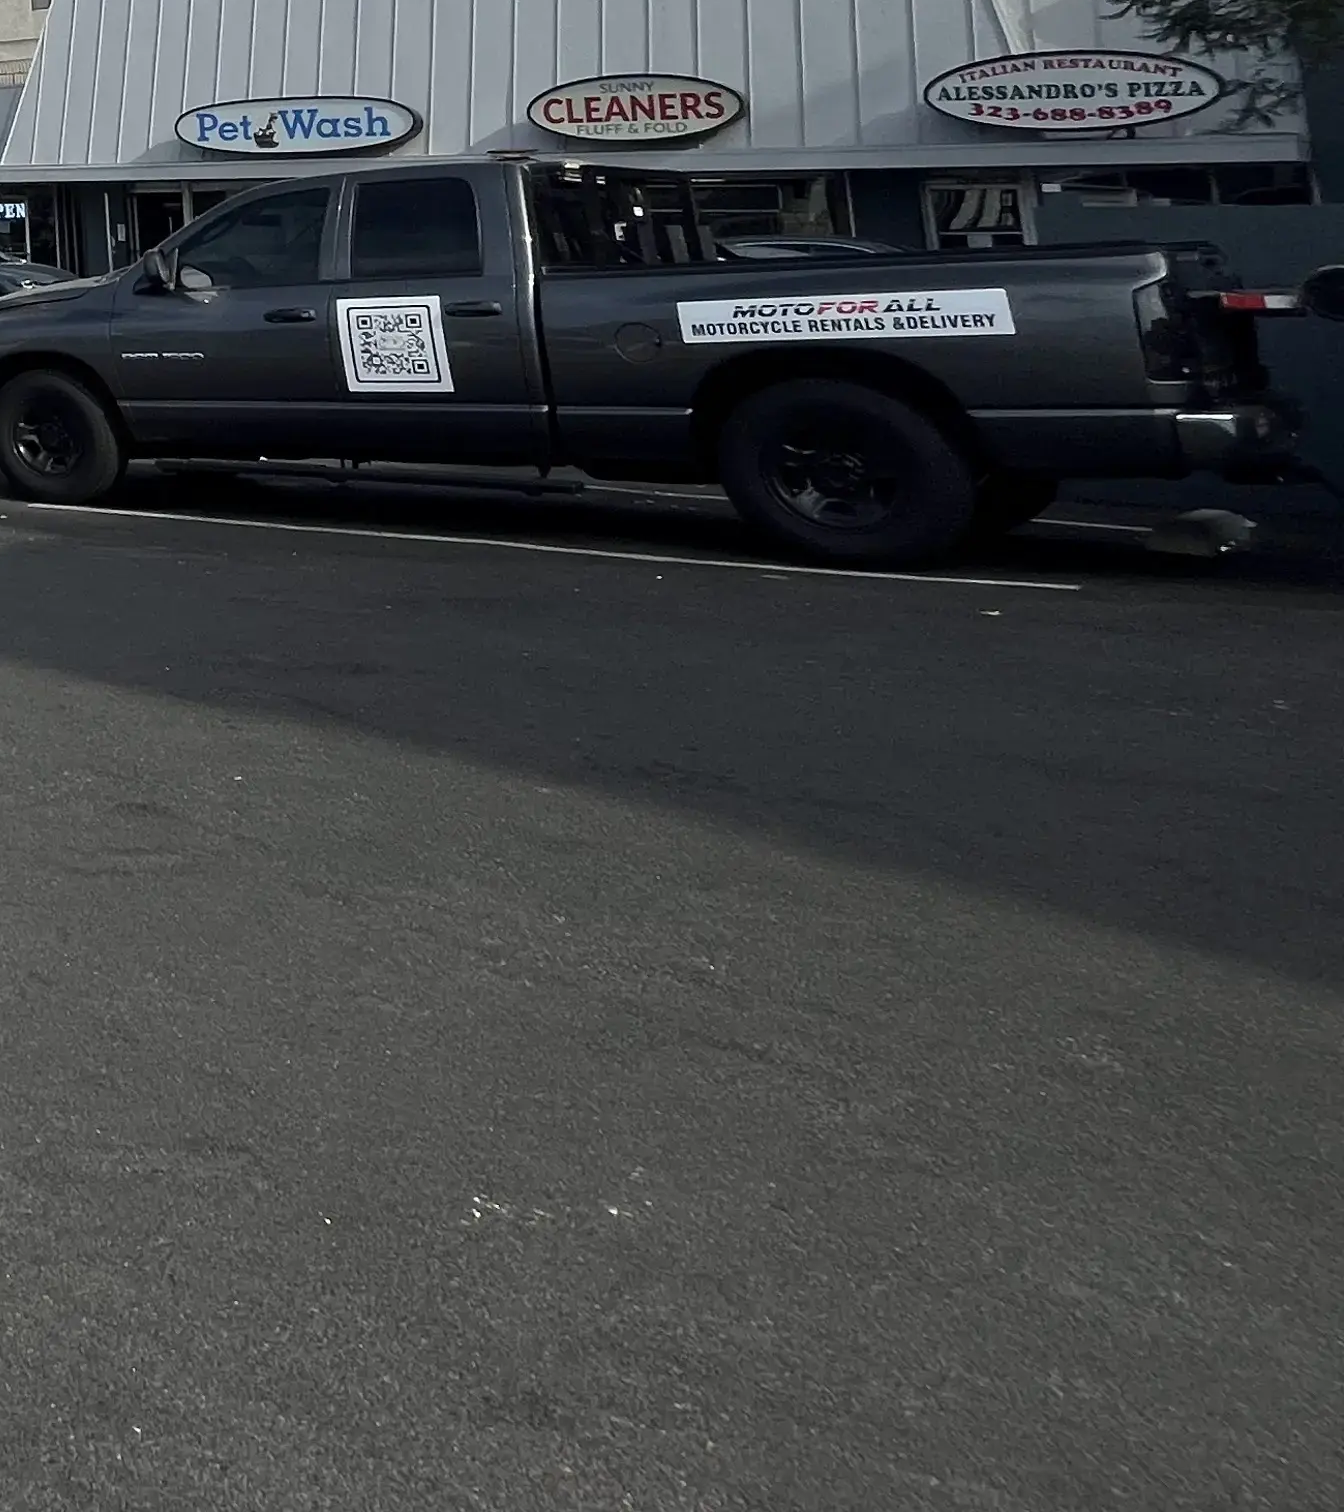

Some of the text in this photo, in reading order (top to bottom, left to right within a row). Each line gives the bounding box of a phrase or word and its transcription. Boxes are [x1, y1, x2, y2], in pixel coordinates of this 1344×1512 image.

[958, 57, 1185, 84] ITALIAN RESTAURANT
[599, 81, 654, 95] SUNNY
[936, 80, 1206, 102] ALESSANDRO'S PIZZA
[543, 91, 725, 124] CLEANERS
[968, 99, 1173, 122] 323-688-8389
[196, 106, 391, 142] Pet Wash
[576, 121, 688, 137] FLUFF & FOLD
[691, 319, 801, 336] MOTORCYCLE
[808, 317, 886, 333] RENTALS
